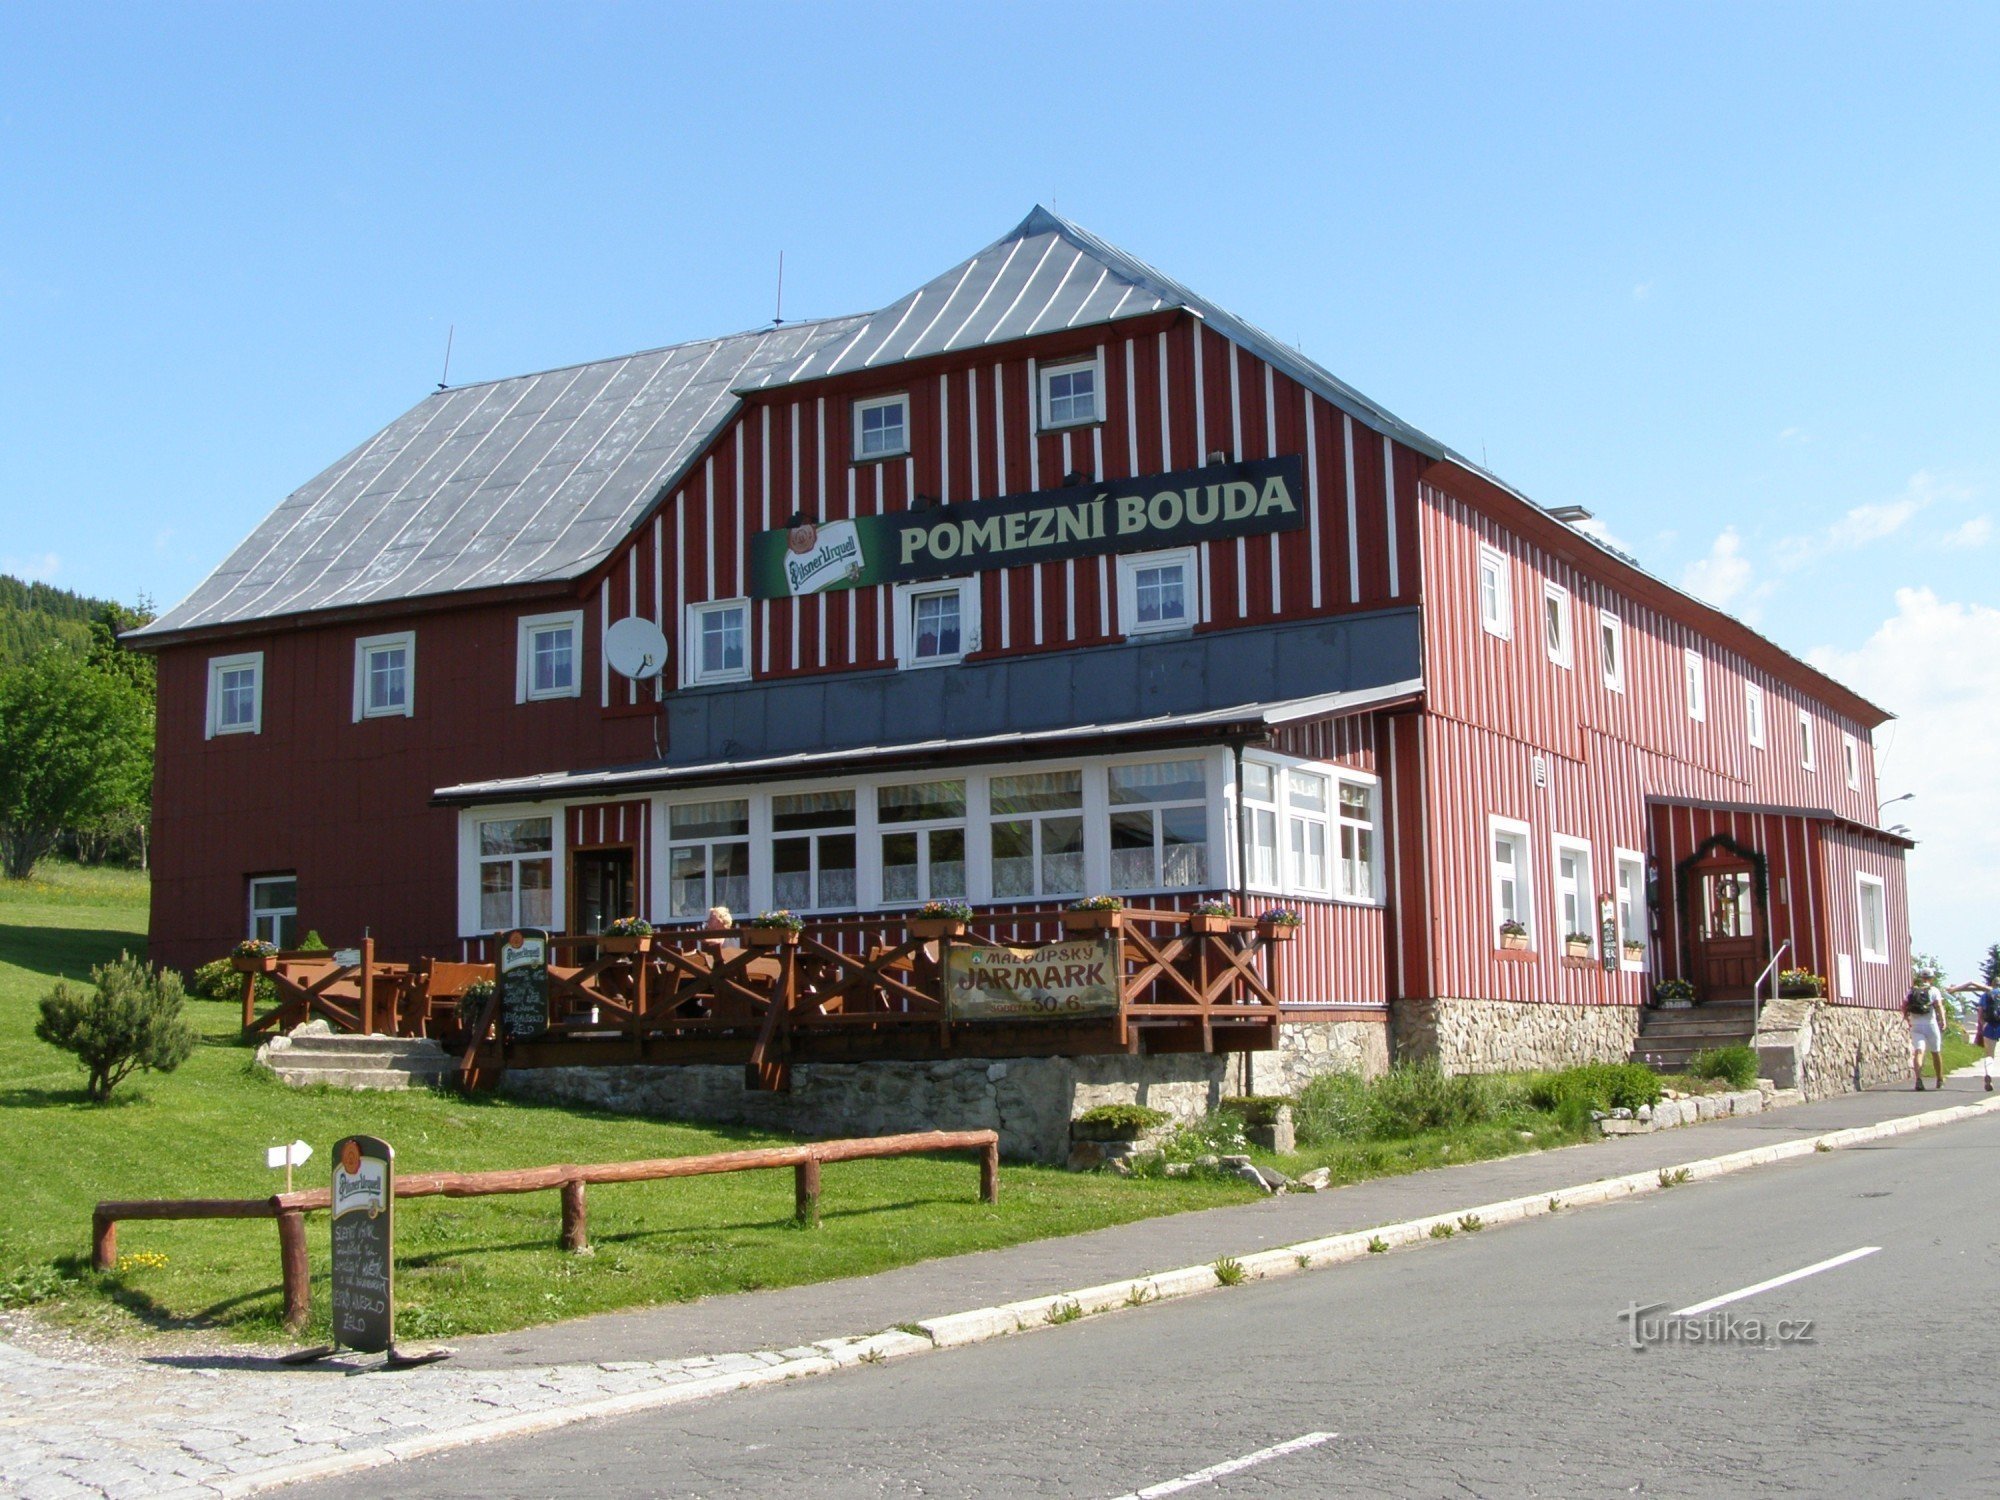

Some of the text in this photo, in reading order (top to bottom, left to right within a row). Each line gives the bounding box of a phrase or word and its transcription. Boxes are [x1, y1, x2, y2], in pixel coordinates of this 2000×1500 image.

[900, 475, 1297, 565] POMEZNÍ BOUDA
[789, 536, 856, 591] Pilsner Urquell
[958, 962, 1106, 991] JARMARK
